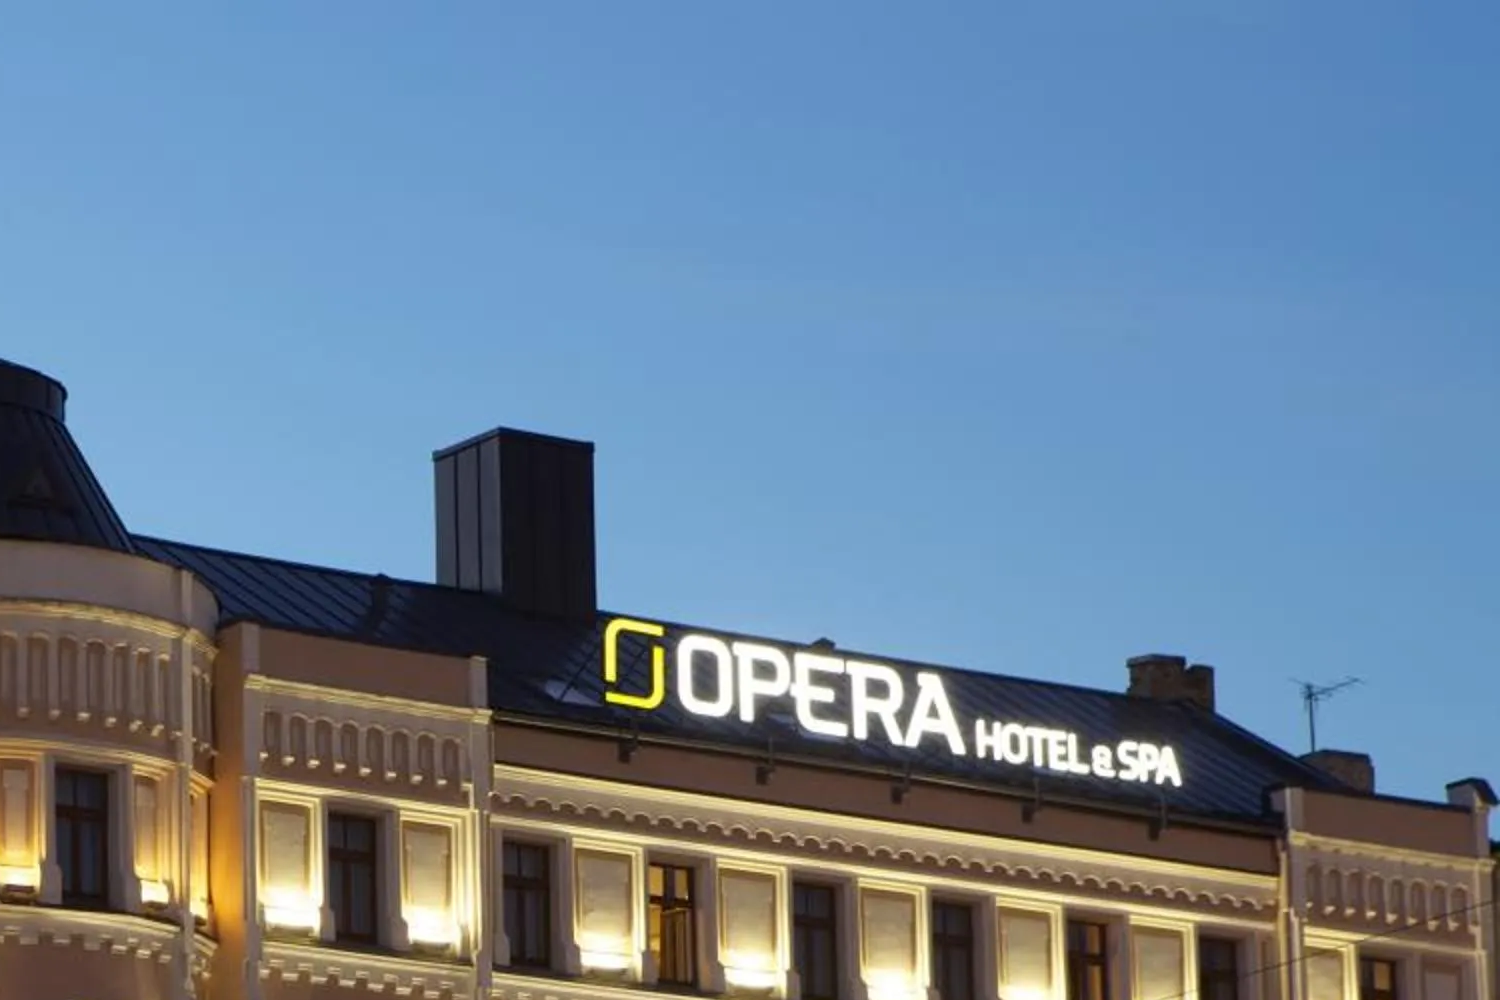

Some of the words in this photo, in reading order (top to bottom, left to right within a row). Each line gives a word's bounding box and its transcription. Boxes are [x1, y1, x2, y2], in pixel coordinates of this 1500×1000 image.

[676, 634, 968, 756] OPERA
[975, 717, 1091, 775] HOTEL
[1091, 744, 1117, 778] &
[1117, 739, 1183, 788] SPA
